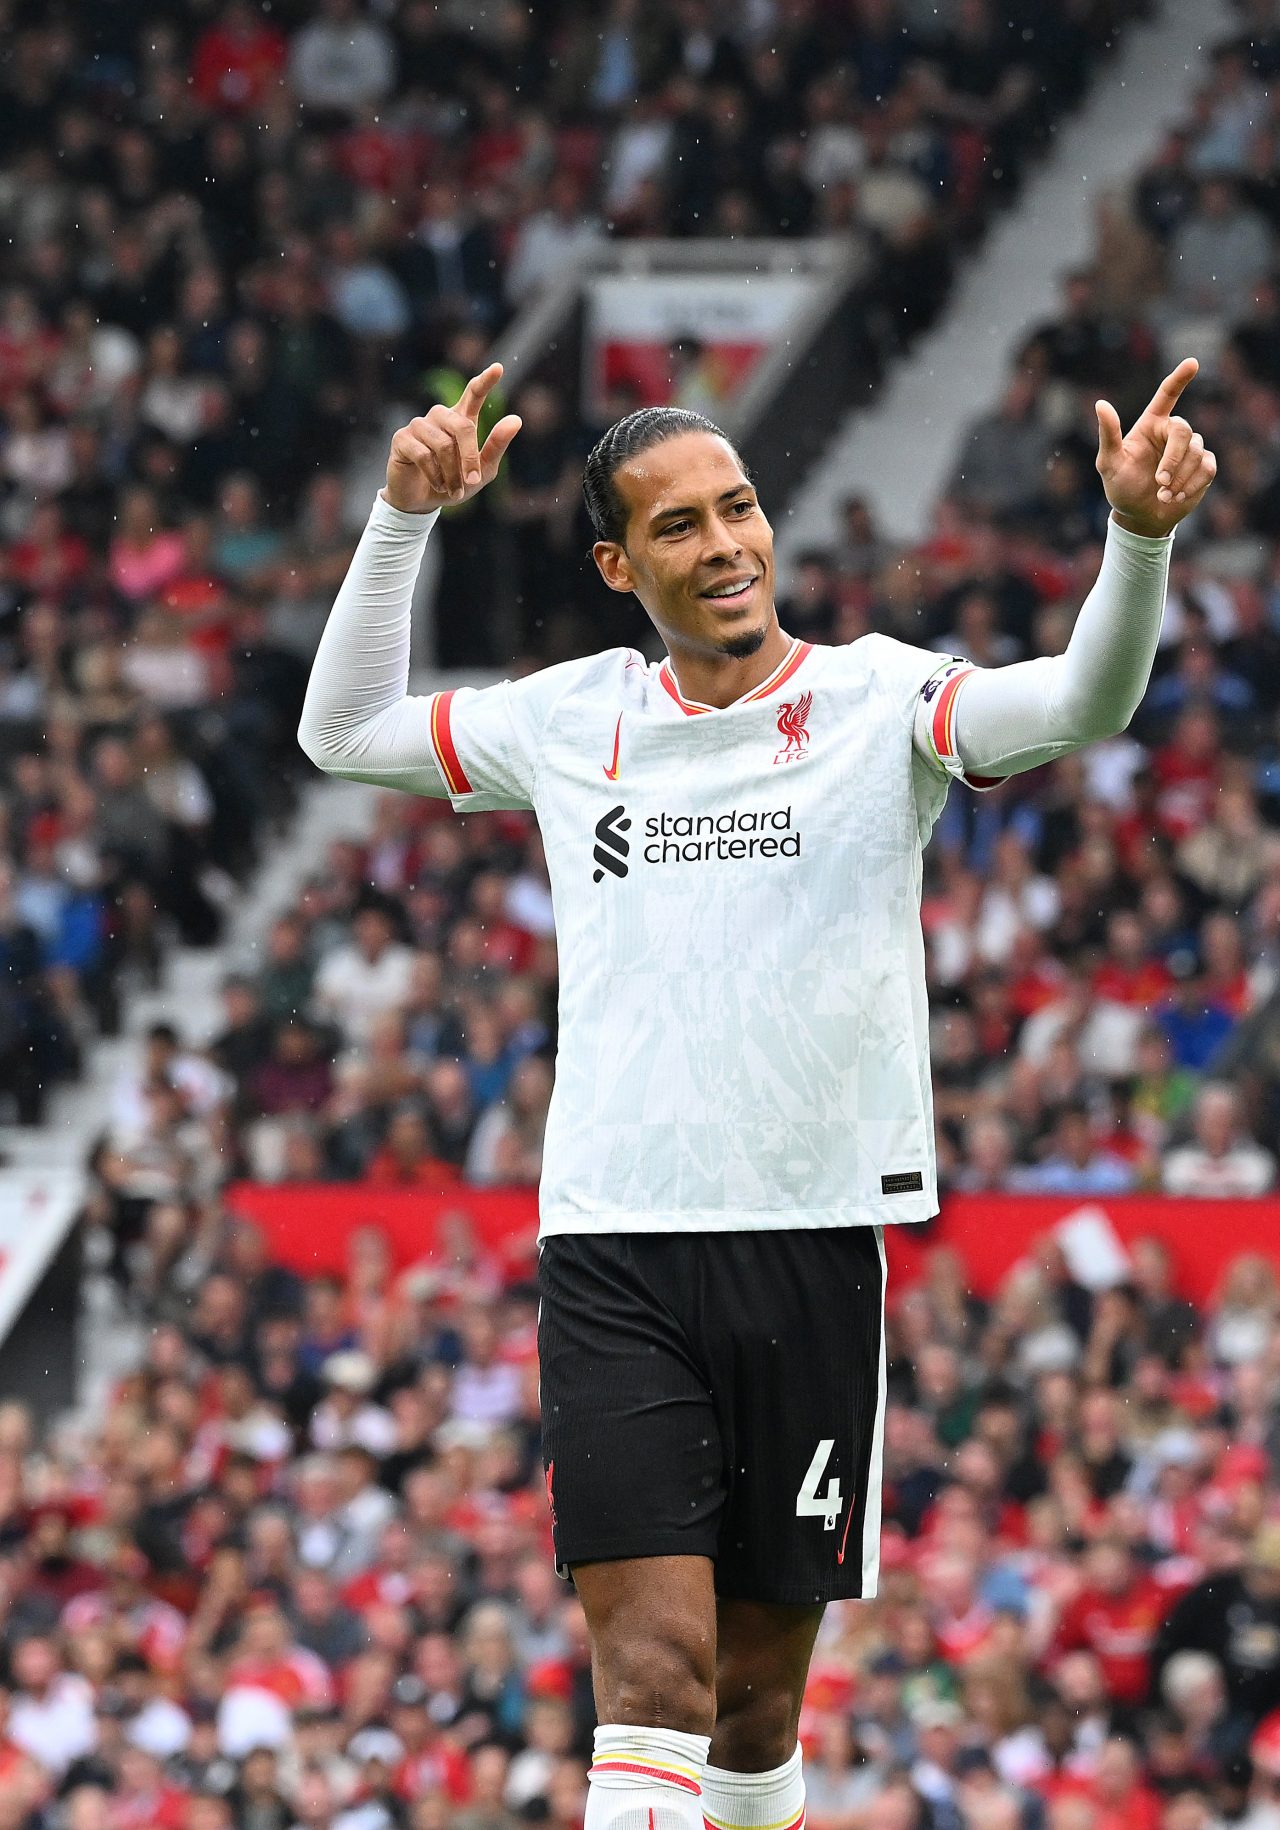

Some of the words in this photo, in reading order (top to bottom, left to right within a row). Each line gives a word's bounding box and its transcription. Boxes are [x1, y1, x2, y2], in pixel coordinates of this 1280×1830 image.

[644, 805, 792, 838] standard
[643, 831, 801, 864] chartered
[796, 1439, 844, 1531] 4
